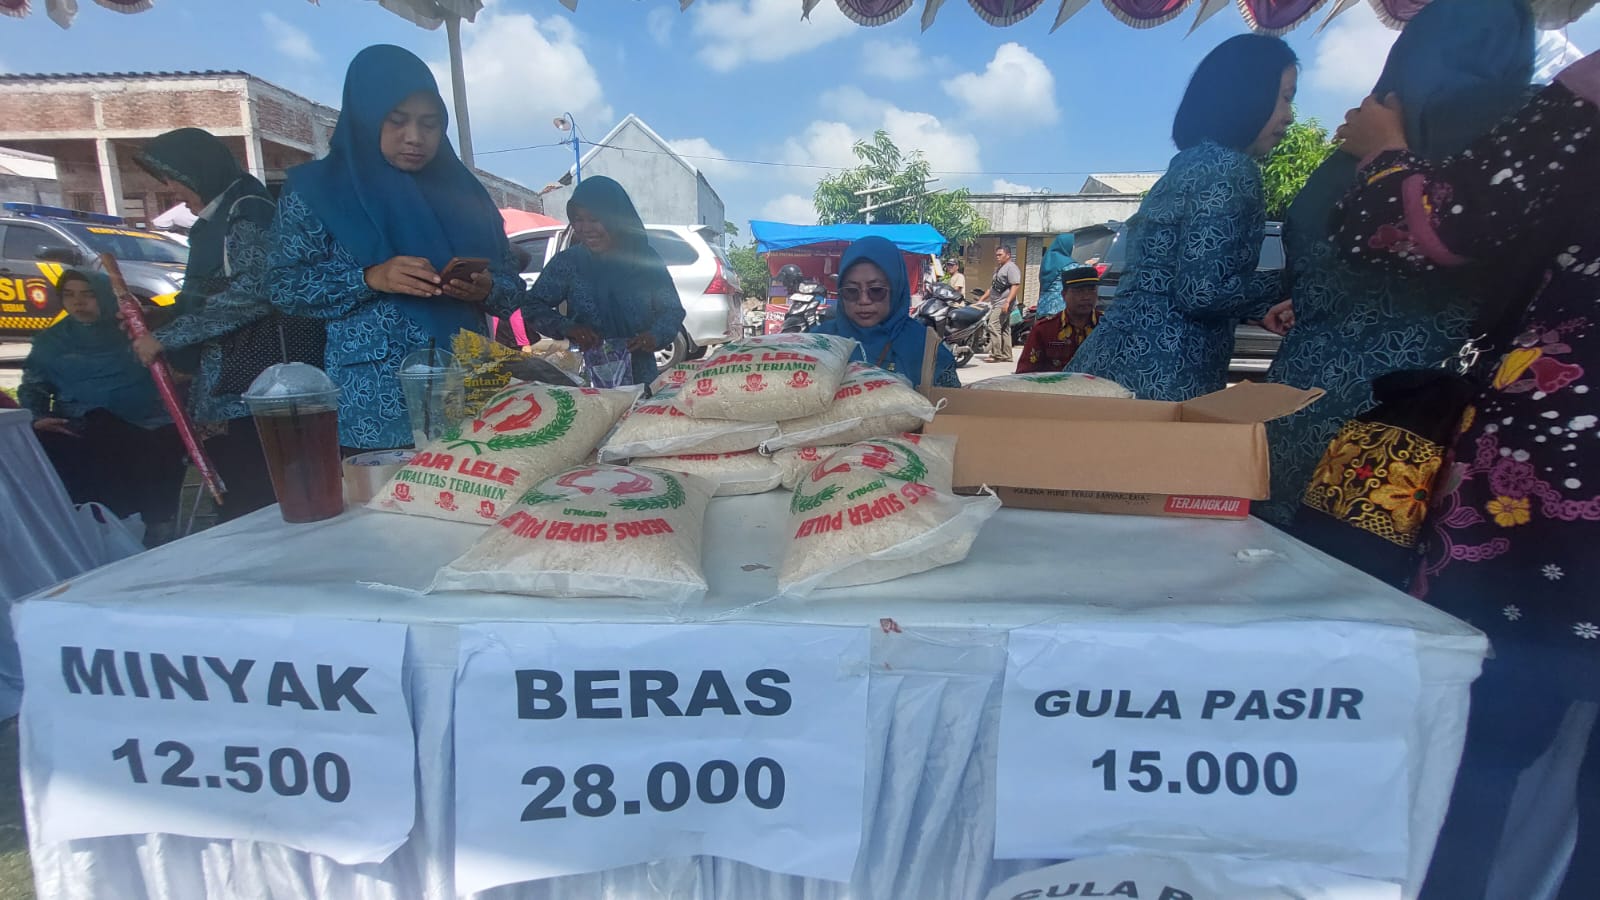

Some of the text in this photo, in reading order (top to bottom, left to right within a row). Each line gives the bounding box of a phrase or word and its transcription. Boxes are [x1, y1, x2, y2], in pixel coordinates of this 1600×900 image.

[756, 362, 817, 373] TERJAMIN
[457, 457, 520, 486] LELE
[449, 478, 507, 501] TERJAMIN
[1170, 497, 1240, 512] TERJANGKAU!
[847, 493, 905, 526] SUPER
[545, 520, 608, 543] SUPER
[615, 518, 673, 541] BERAS
[61, 646, 378, 714] MINYAK
[515, 668, 793, 720] BERAS
[1034, 687, 1364, 721] GULA PASIR
[112, 738, 351, 803] 12.500
[1092, 749, 1298, 796] 15.000
[520, 757, 786, 822] 28.000
